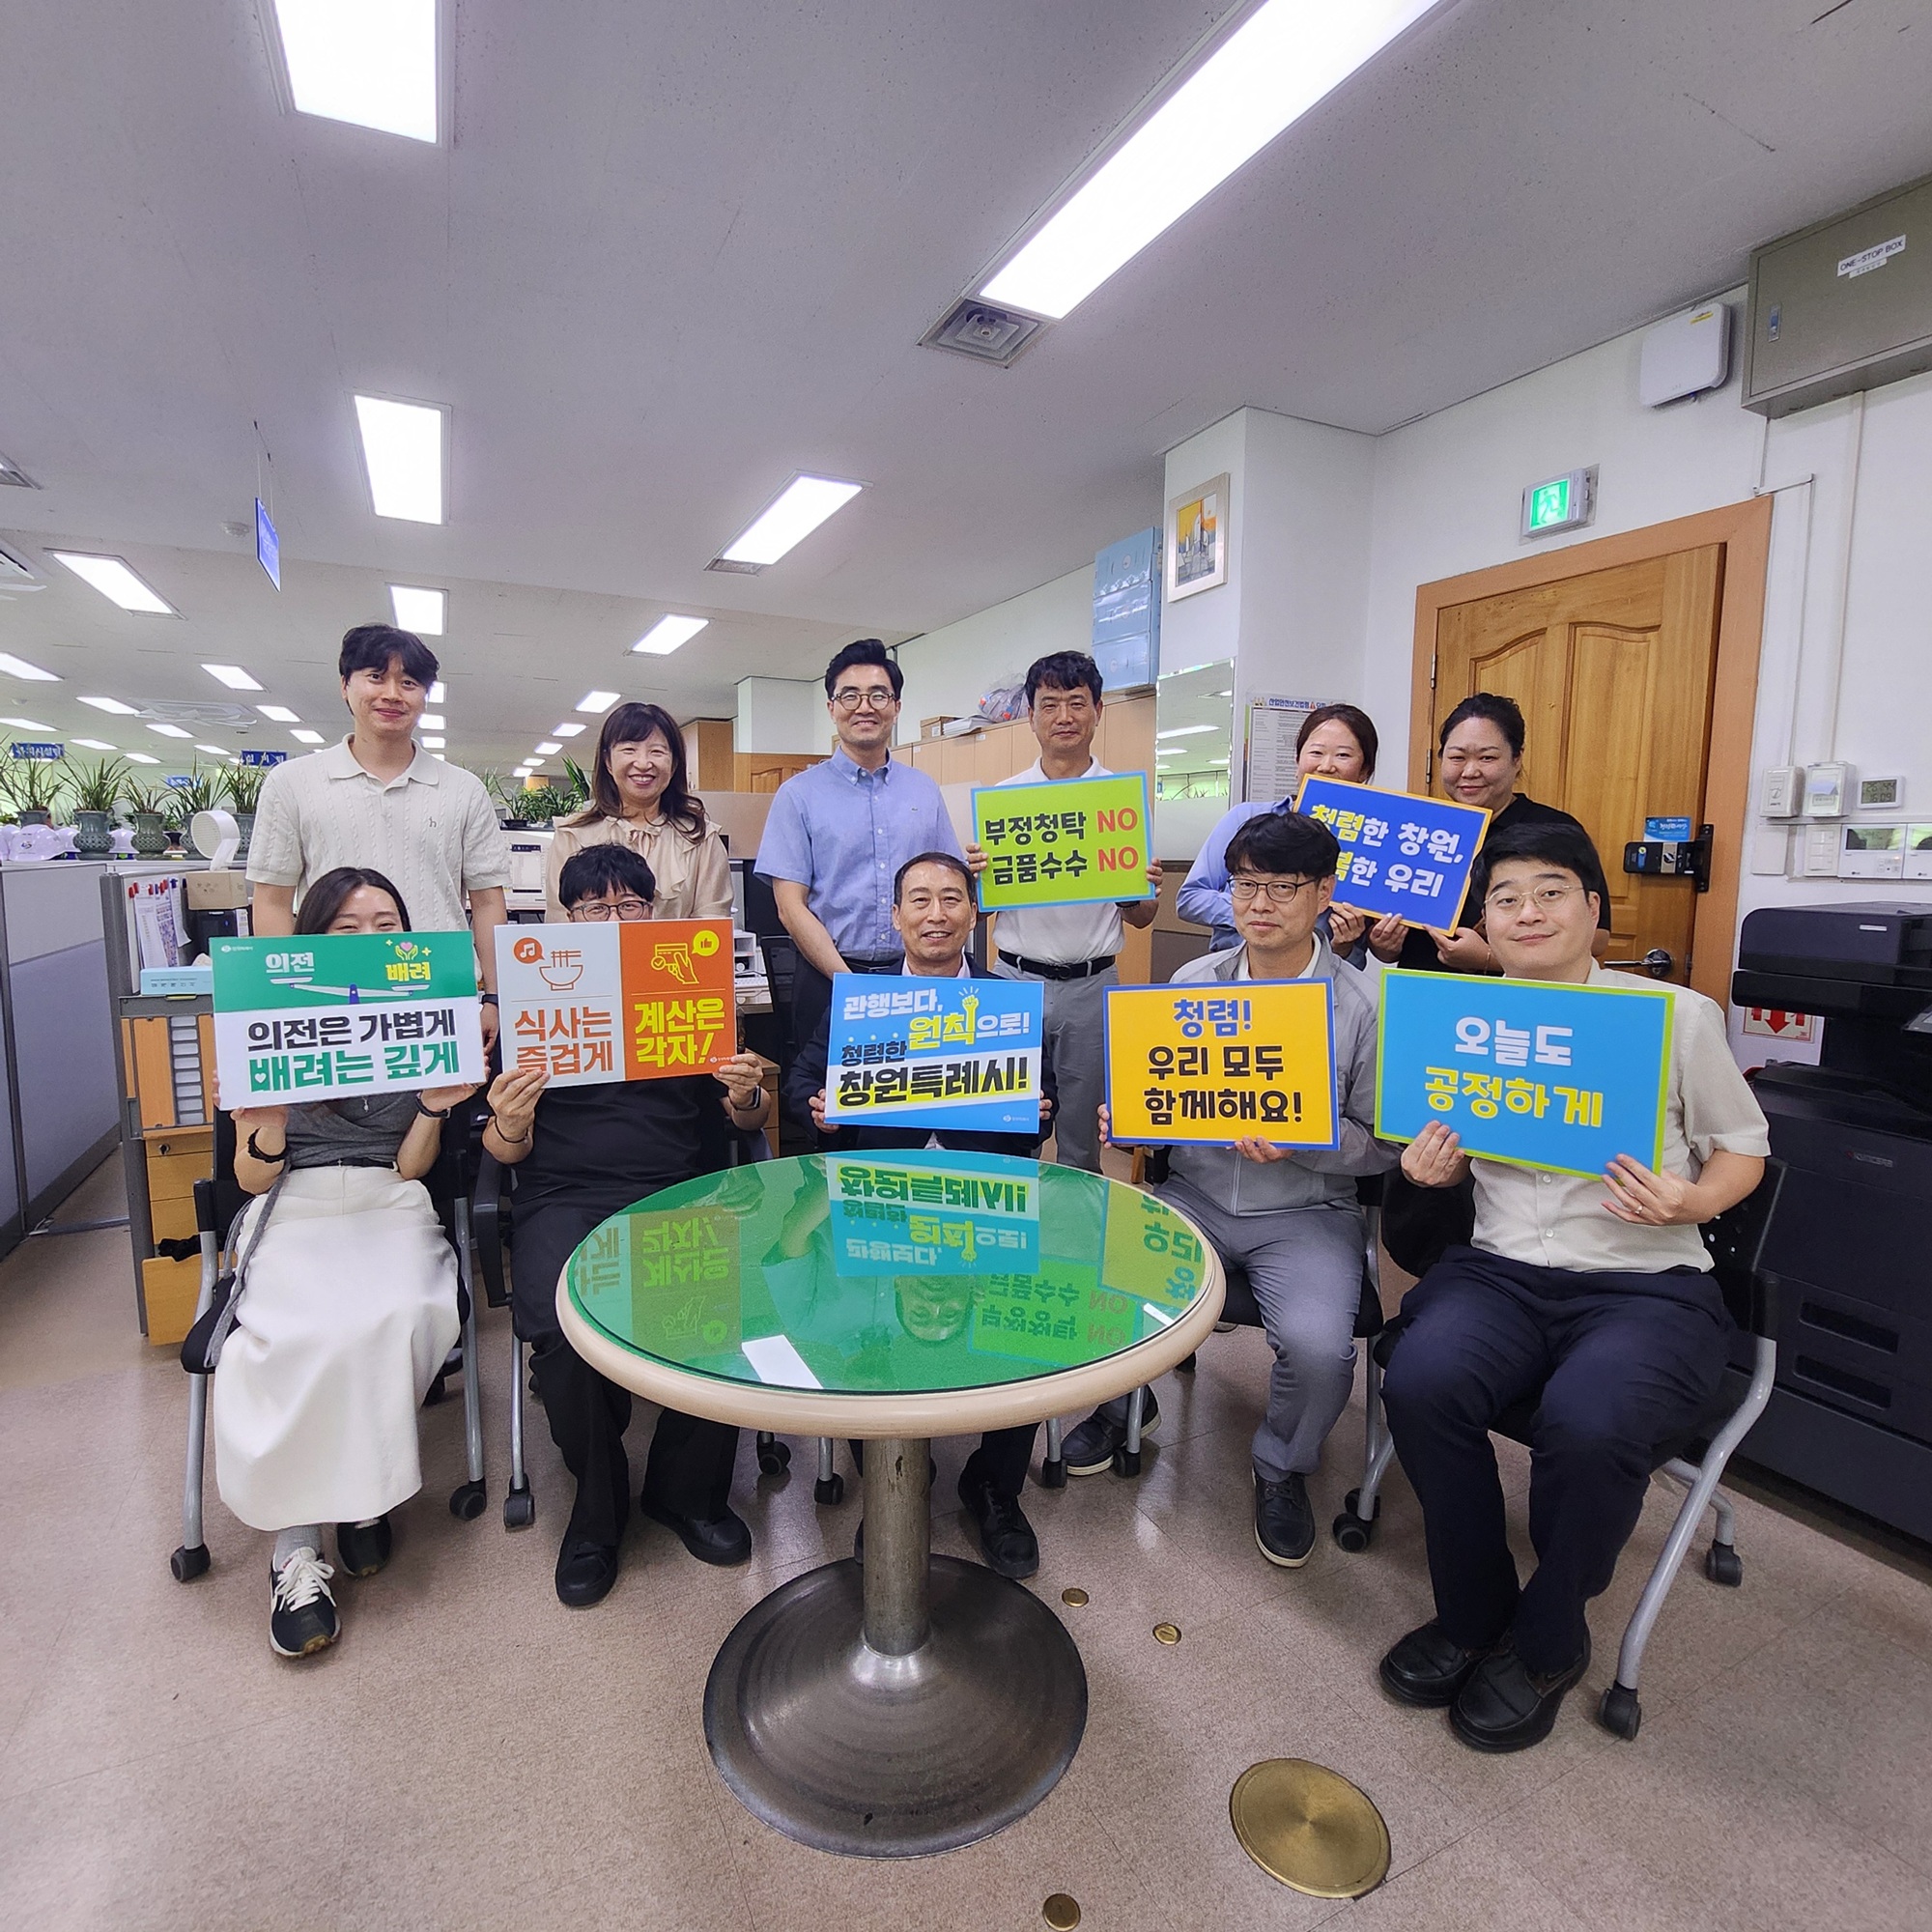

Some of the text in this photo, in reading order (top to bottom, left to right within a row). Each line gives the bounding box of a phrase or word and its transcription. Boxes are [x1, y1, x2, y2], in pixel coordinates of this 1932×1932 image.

[1839, 247, 1884, 271] ONE-STOP
[1886, 240, 1903, 253] BOX
[984, 808, 1138, 846] 부정청탁 NO
[1397, 822, 1463, 864] 창원,
[992, 846, 1139, 886] 금품수수 NO
[1384, 864, 1444, 897] 우리
[266, 952, 315, 974] 의전
[385, 962, 431, 981] 배려
[634, 998, 725, 1034] 계산은
[843, 988, 944, 1020] 관행보다,
[1173, 998, 1252, 1038] 청렴!
[247, 1009, 457, 1052] 의전은 가볍게
[514, 1006, 612, 1041] 식사는
[908, 1009, 1031, 1050] 원칙으로!
[1455, 1016, 1574, 1066] 오늘도
[249, 1041, 461, 1093] 배려는 깊게
[516, 1040, 614, 1075] 즐겁게
[636, 1032, 715, 1067] 각자!
[841, 1039, 908, 1067] 청렴한
[1148, 1045, 1285, 1081] 우리 모두
[838, 1057, 1029, 1106] 창원특례시!
[1424, 1066, 1604, 1128] 공정하게
[1143, 1087, 1302, 1125] 함께해요!
